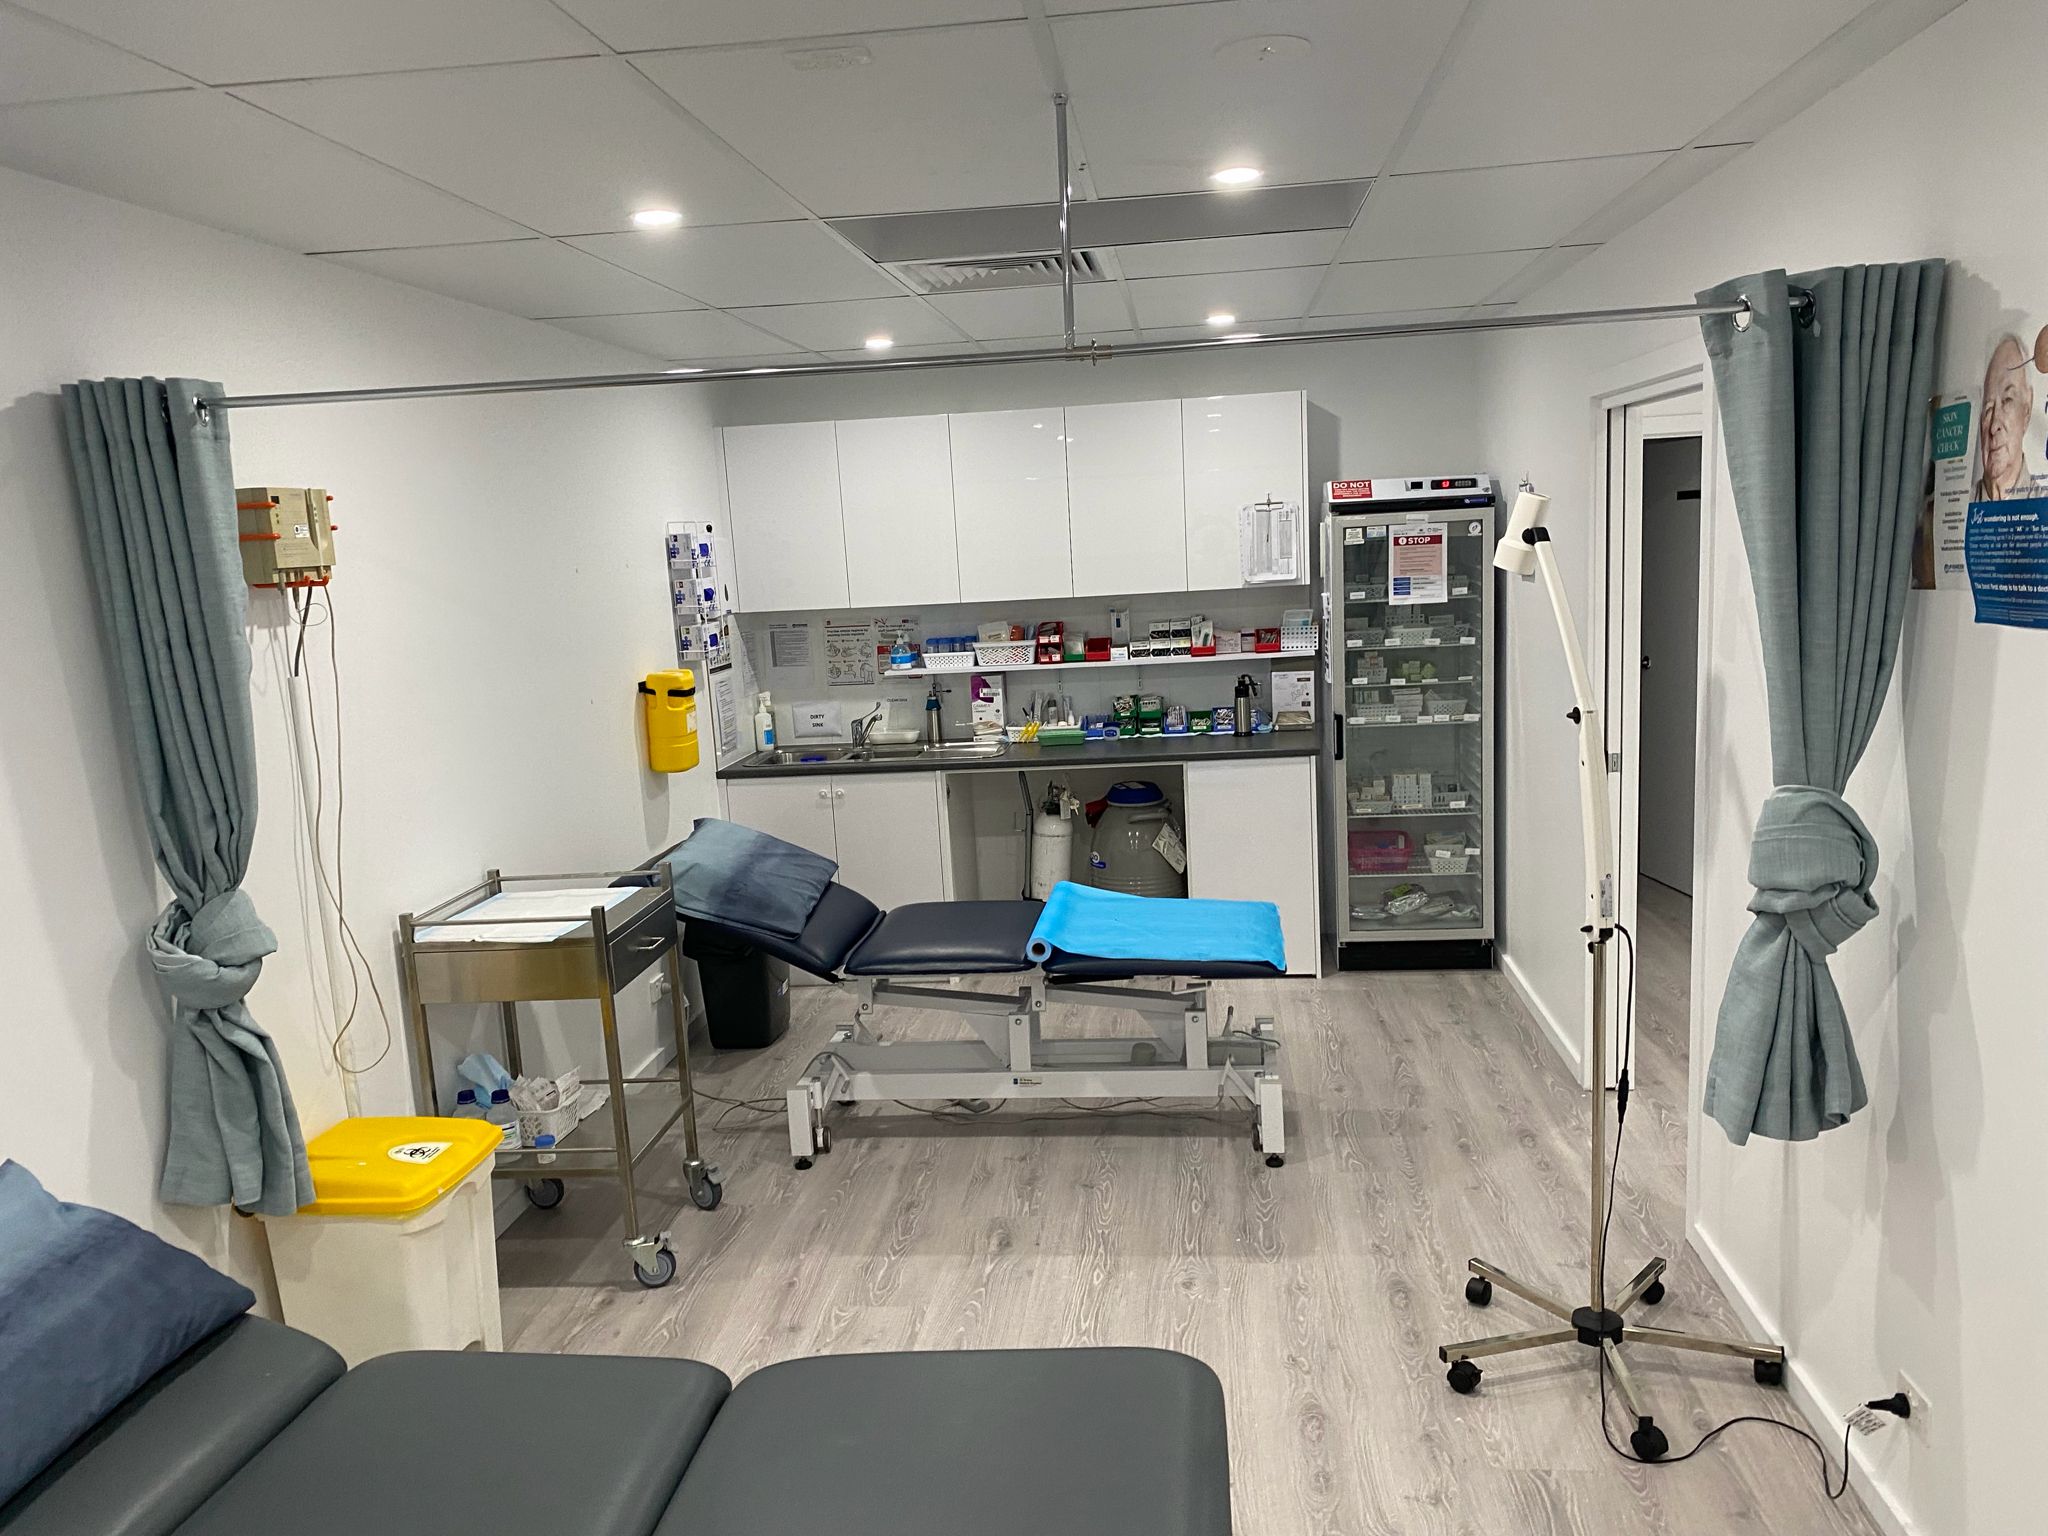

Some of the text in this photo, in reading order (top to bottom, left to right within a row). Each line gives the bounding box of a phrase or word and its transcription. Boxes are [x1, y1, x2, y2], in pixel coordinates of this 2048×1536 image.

[1936, 424, 1963, 440] CANCER
[1937, 440, 1959, 453] CHECK
[1984, 514, 2006, 523] wondering
